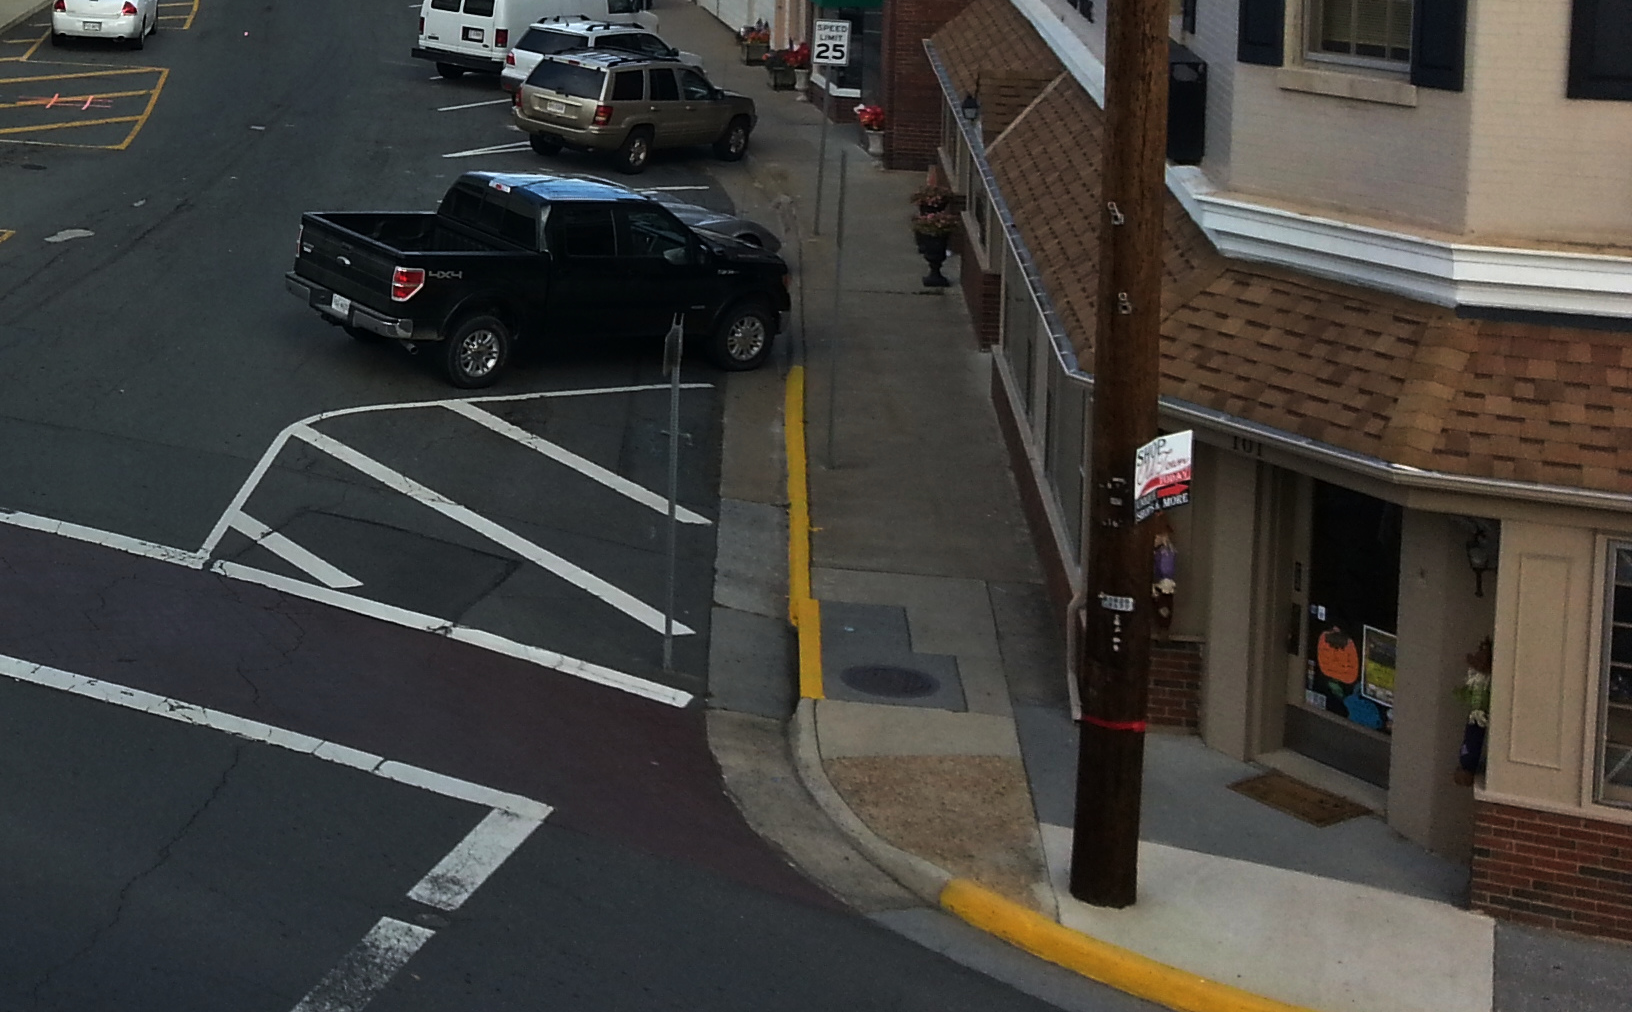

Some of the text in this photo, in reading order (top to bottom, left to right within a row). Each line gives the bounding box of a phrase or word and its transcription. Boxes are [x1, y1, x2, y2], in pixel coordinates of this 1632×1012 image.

[817, 25, 847, 33] SPEED
[820, 34, 843, 42] LIMIT
[815, 43, 845, 60] 25
[428, 270, 463, 279] 4X4
[1137, 438, 1167, 467] SHOP
[1232, 435, 1262, 457] 101
[1162, 492, 1188, 508] MORE
